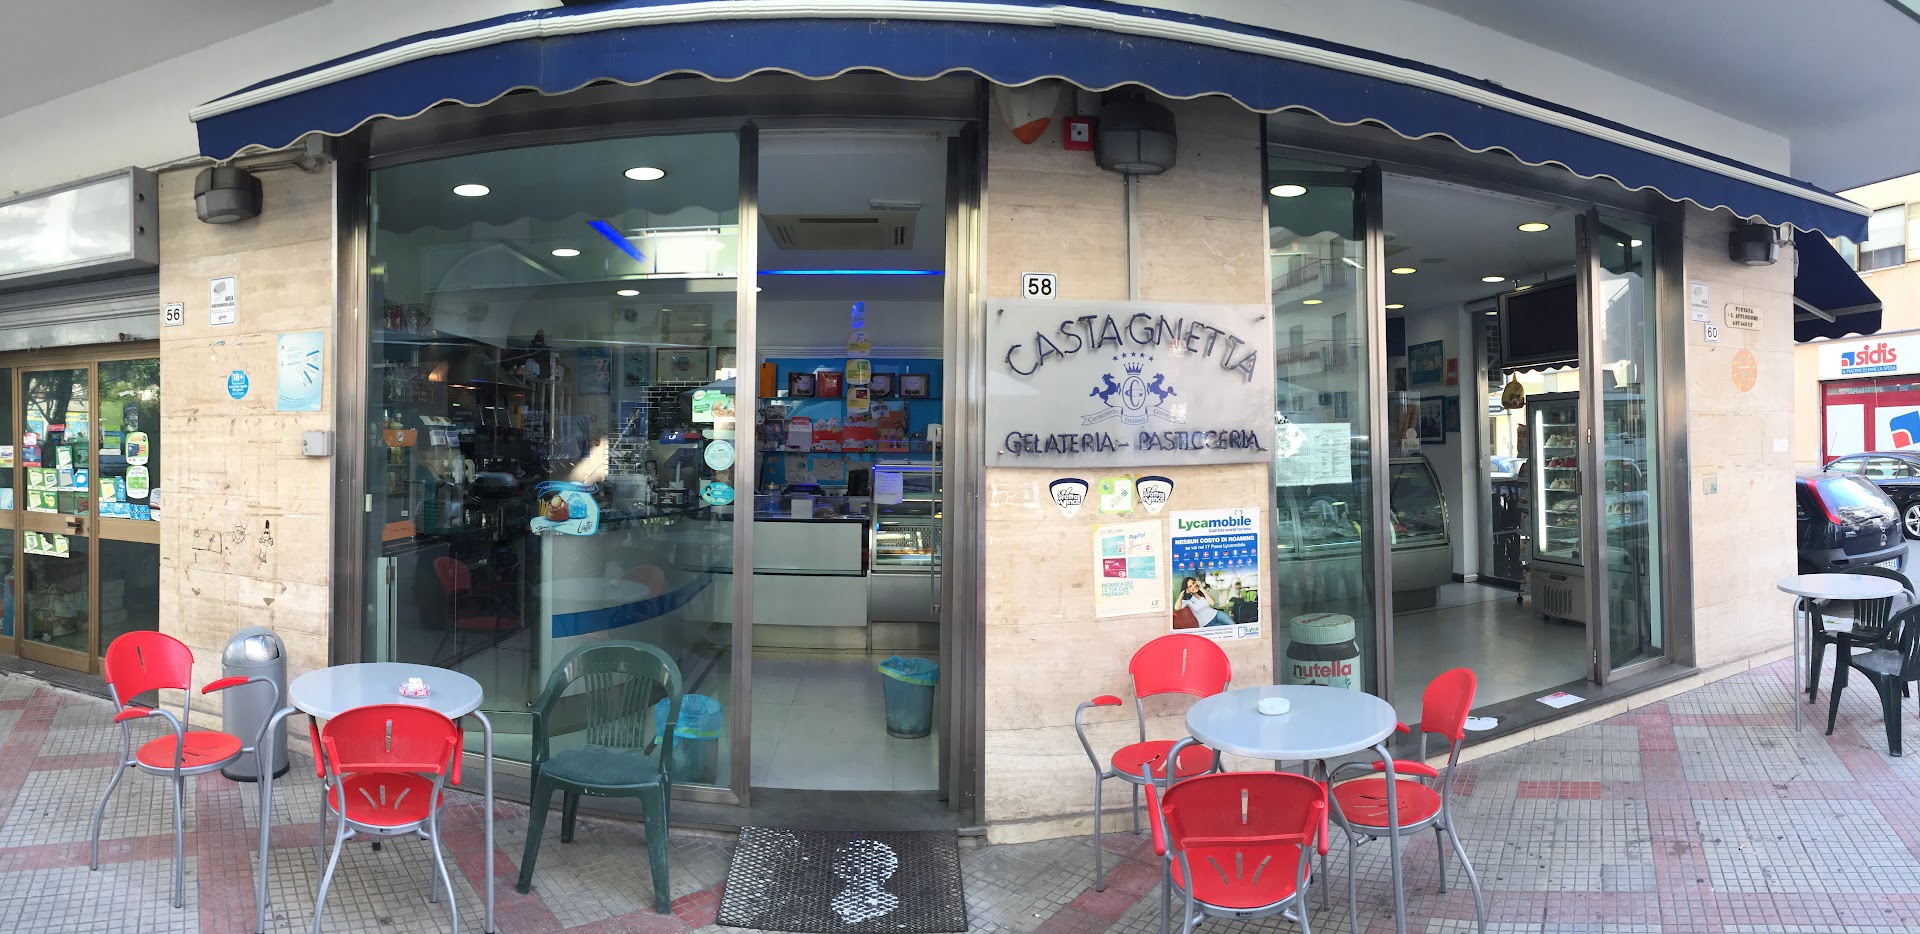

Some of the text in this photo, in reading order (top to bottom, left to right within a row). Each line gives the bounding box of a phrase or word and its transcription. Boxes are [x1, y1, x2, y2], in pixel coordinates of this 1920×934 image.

[1028, 278, 1052, 296] 58
[167, 309, 180, 321] 56
[1735, 306, 1754, 314] VIETATA
[1708, 327, 1718, 338] 60
[1005, 312, 1258, 382] CASTAGNETTA
[1856, 343, 1897, 365] sidis
[233, 373, 244, 381] 18+
[1005, 431, 1115, 454] GELATERIA
[1138, 430, 1261, 451] PASTICCERIA
[1178, 516, 1251, 531] Lycamobile
[1129, 532, 1146, 540] PayPal
[1293, 660, 1352, 678] nutella
